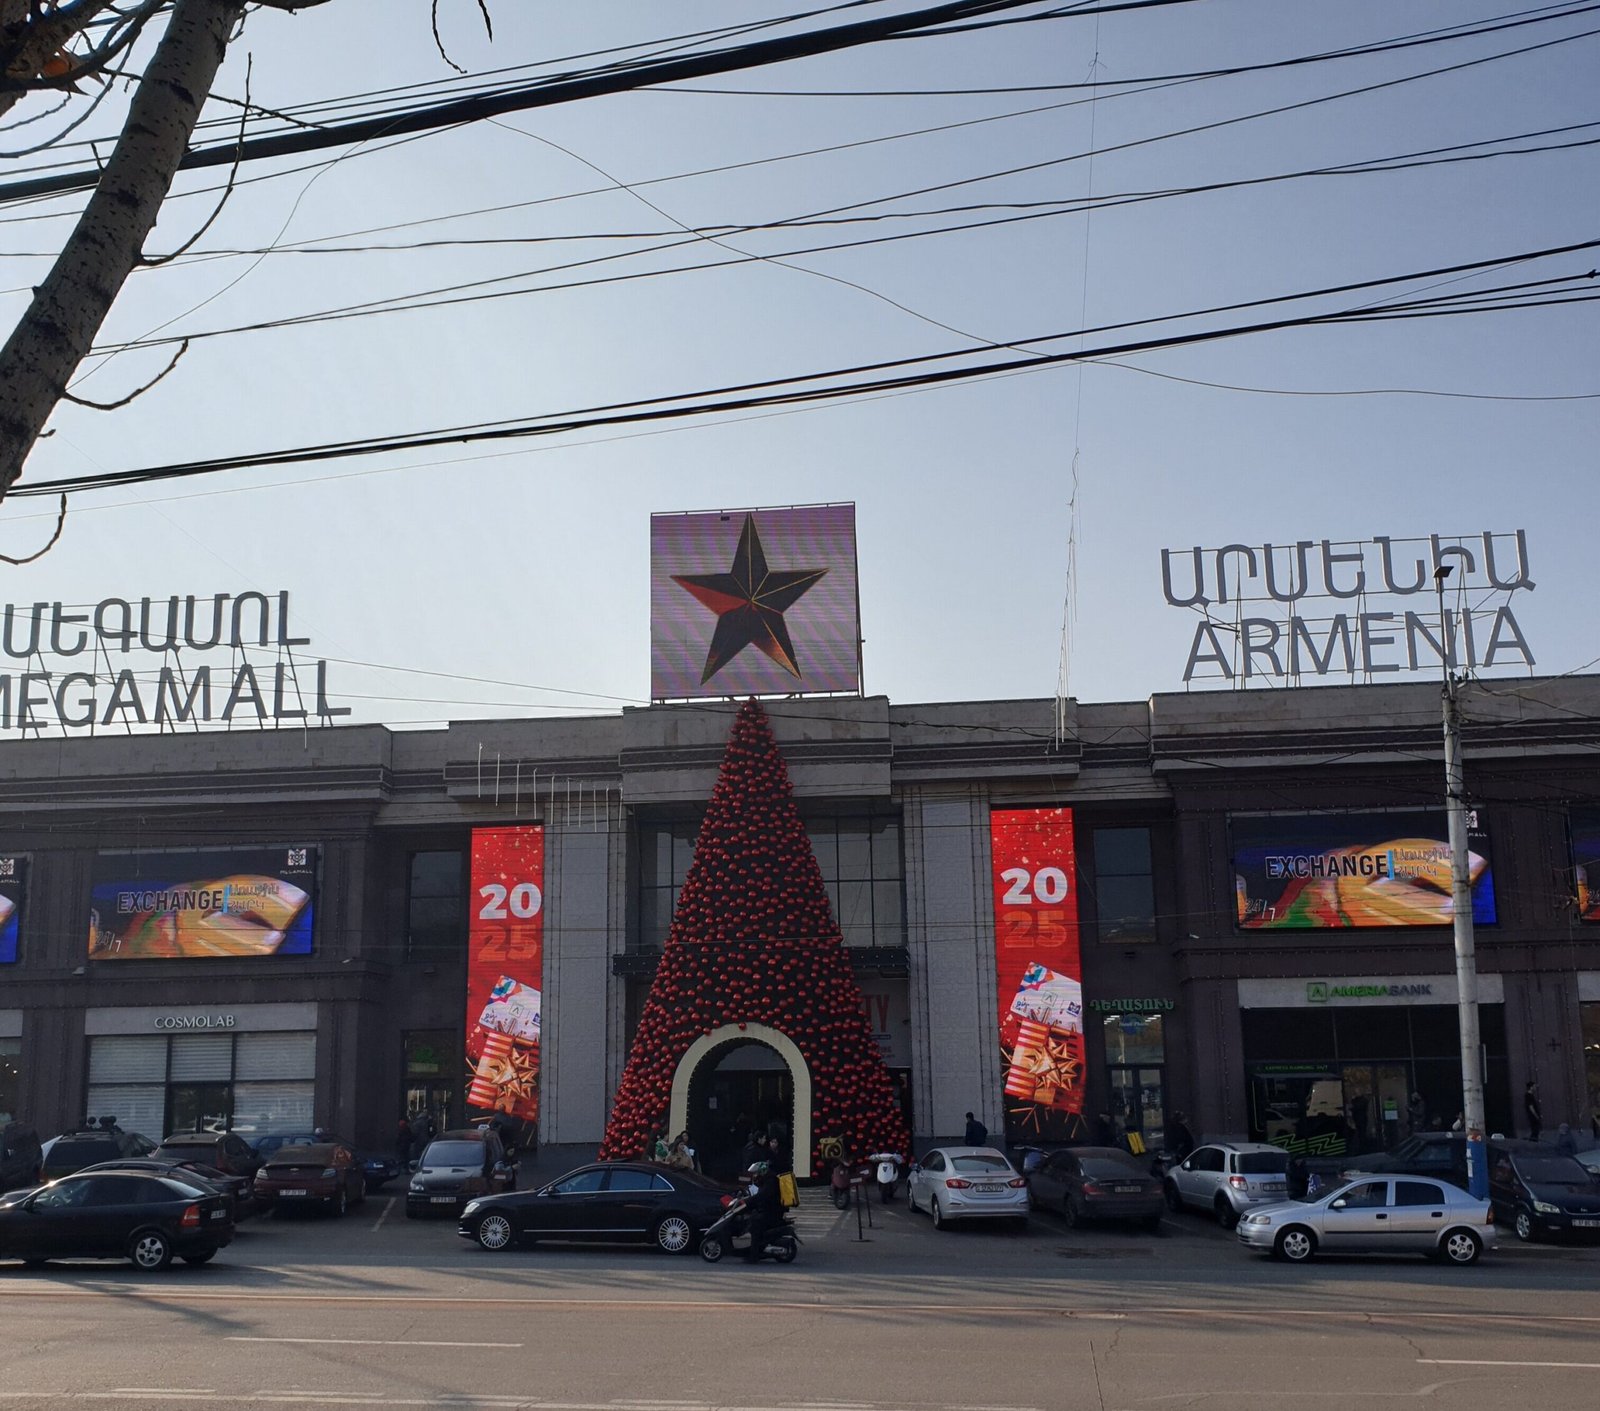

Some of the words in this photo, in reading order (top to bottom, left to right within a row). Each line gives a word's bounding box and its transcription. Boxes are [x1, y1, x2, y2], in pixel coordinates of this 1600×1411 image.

[1161, 529, 1536, 608] ԱՐՄԵՆԻԱ
[3, 590, 311, 658] ՄԵԳԱՄՈԼ
[1182, 606, 1536, 682] ARMENIA
[0, 660, 352, 729] EGAMALL
[1001, 867, 1068, 905] 20
[1265, 854, 1389, 880] EXCHANGE
[117, 889, 223, 914] EXCHANGE
[478, 882, 542, 920] 20
[477, 924, 538, 962] 25
[1002, 910, 1068, 949] 25
[154, 1015, 235, 1030] COSMOLAB
